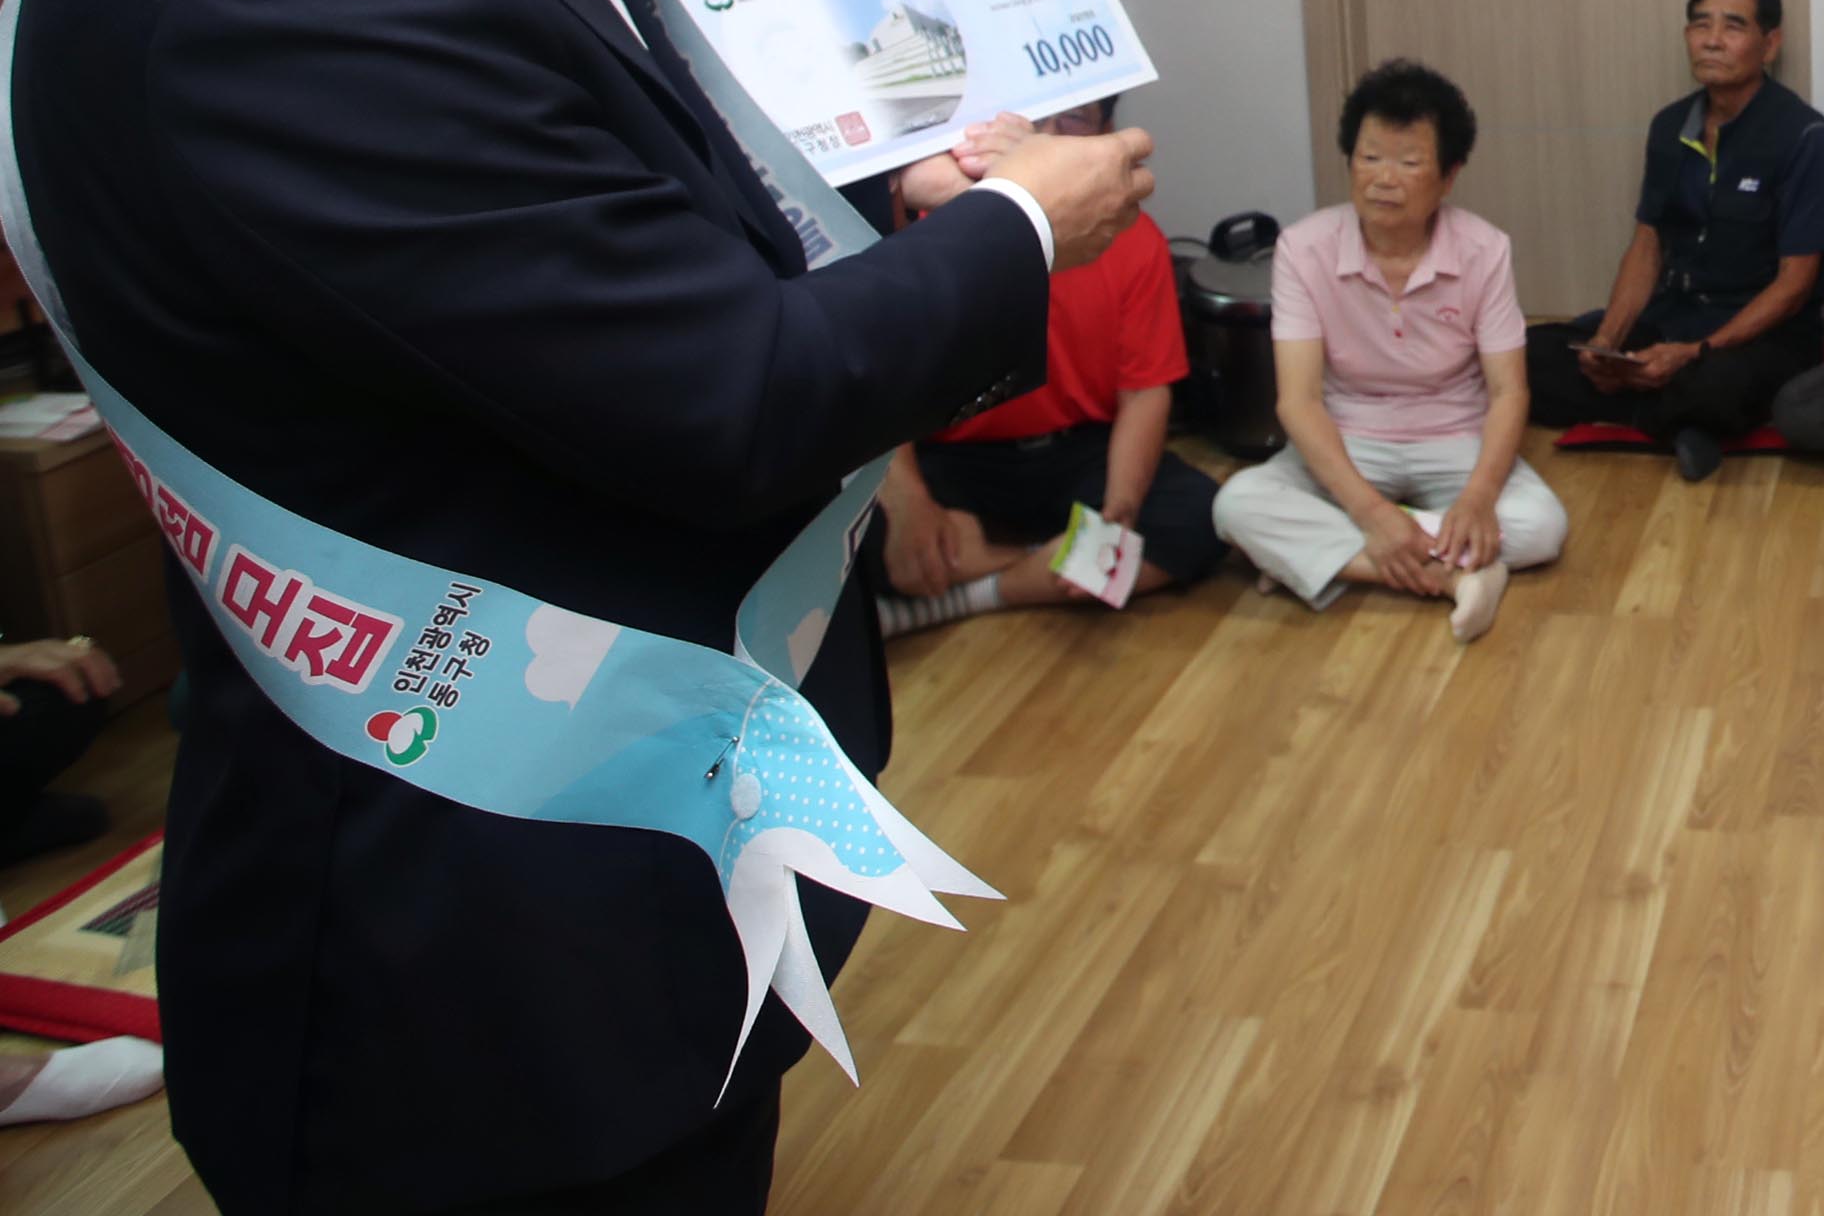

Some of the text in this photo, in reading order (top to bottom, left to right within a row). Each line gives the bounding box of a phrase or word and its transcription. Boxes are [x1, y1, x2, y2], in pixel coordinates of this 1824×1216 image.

[1023, 24, 1115, 78] 10,000
[221, 552, 395, 686] 모집
[392, 581, 483, 695] 인천광역시
[428, 630, 491, 710] 동구청
